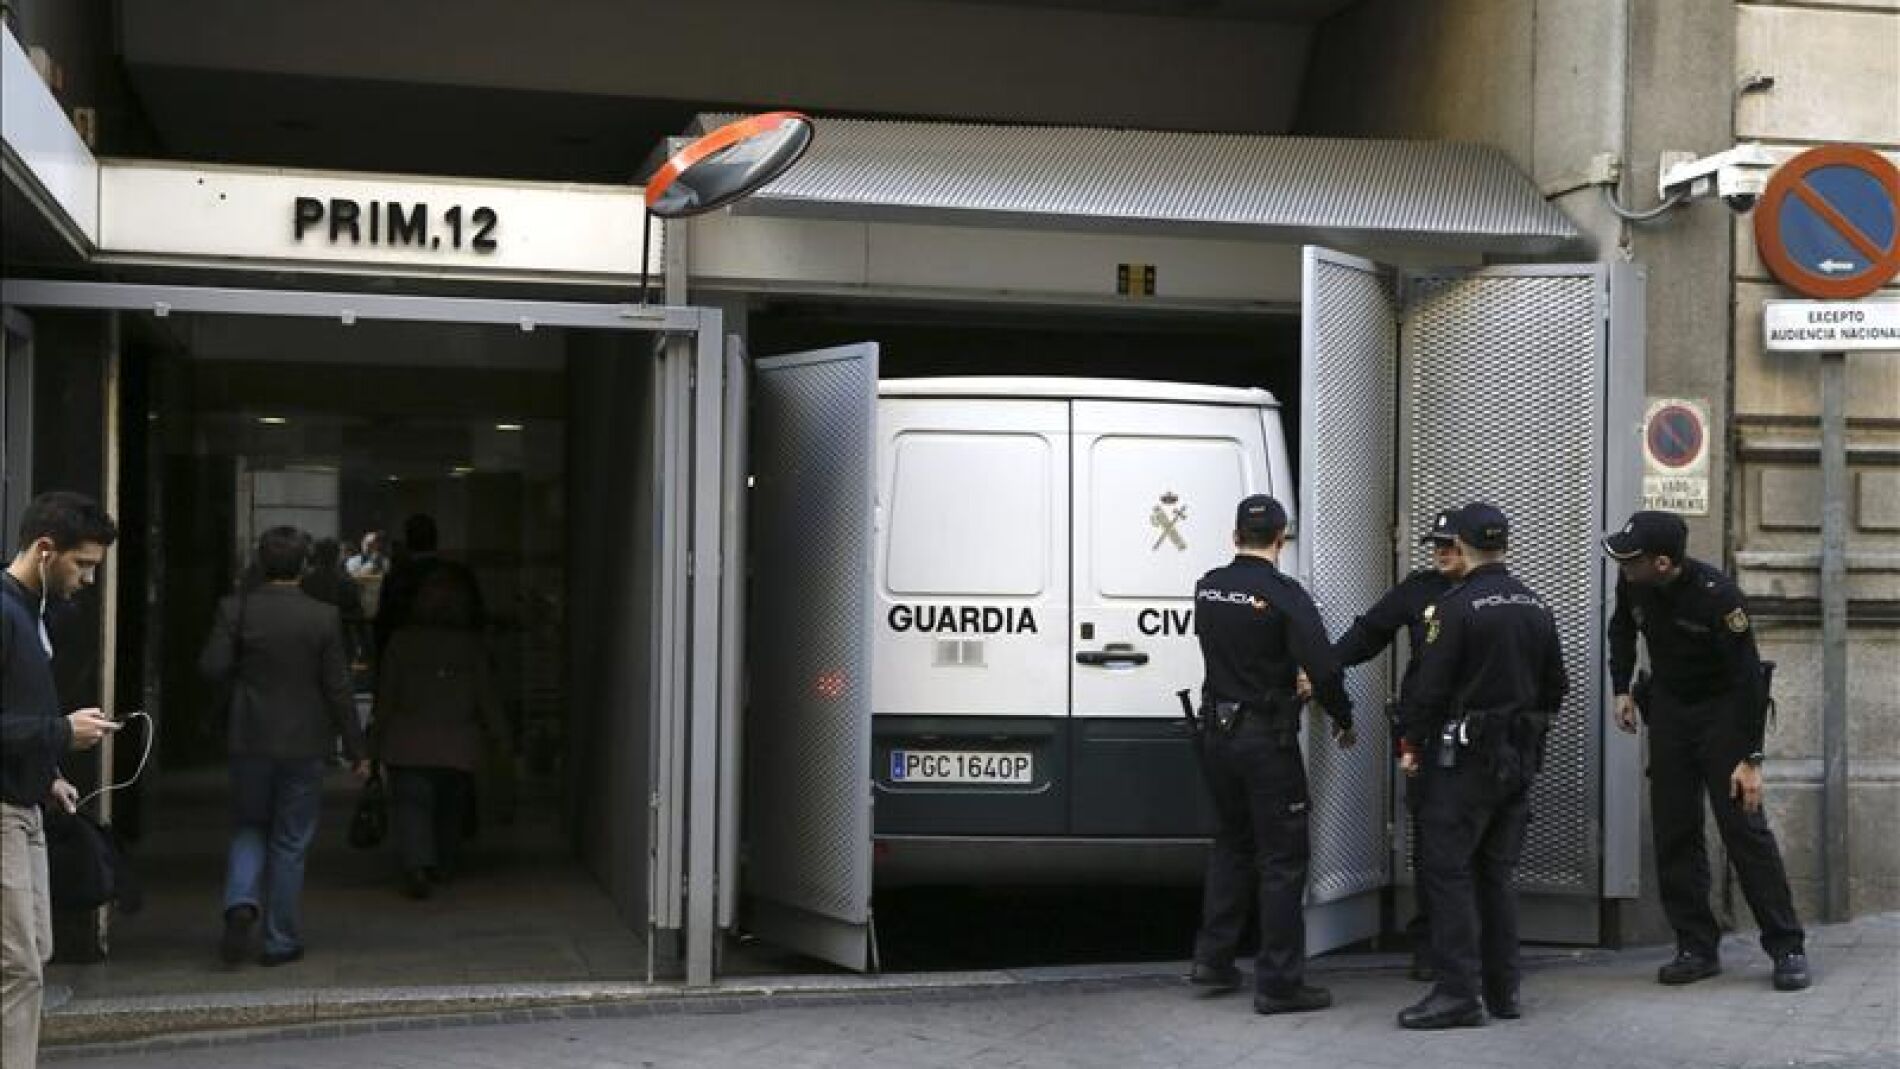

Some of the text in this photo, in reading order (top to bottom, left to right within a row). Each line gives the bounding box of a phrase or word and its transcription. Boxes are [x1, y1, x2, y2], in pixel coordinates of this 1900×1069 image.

[1807, 310, 1865, 324] EXCEPTO
[1771, 328, 1836, 341] AUDIENCIA
[887, 605, 1199, 636] GUARDIA CIV
[906, 754, 950, 778] PGC
